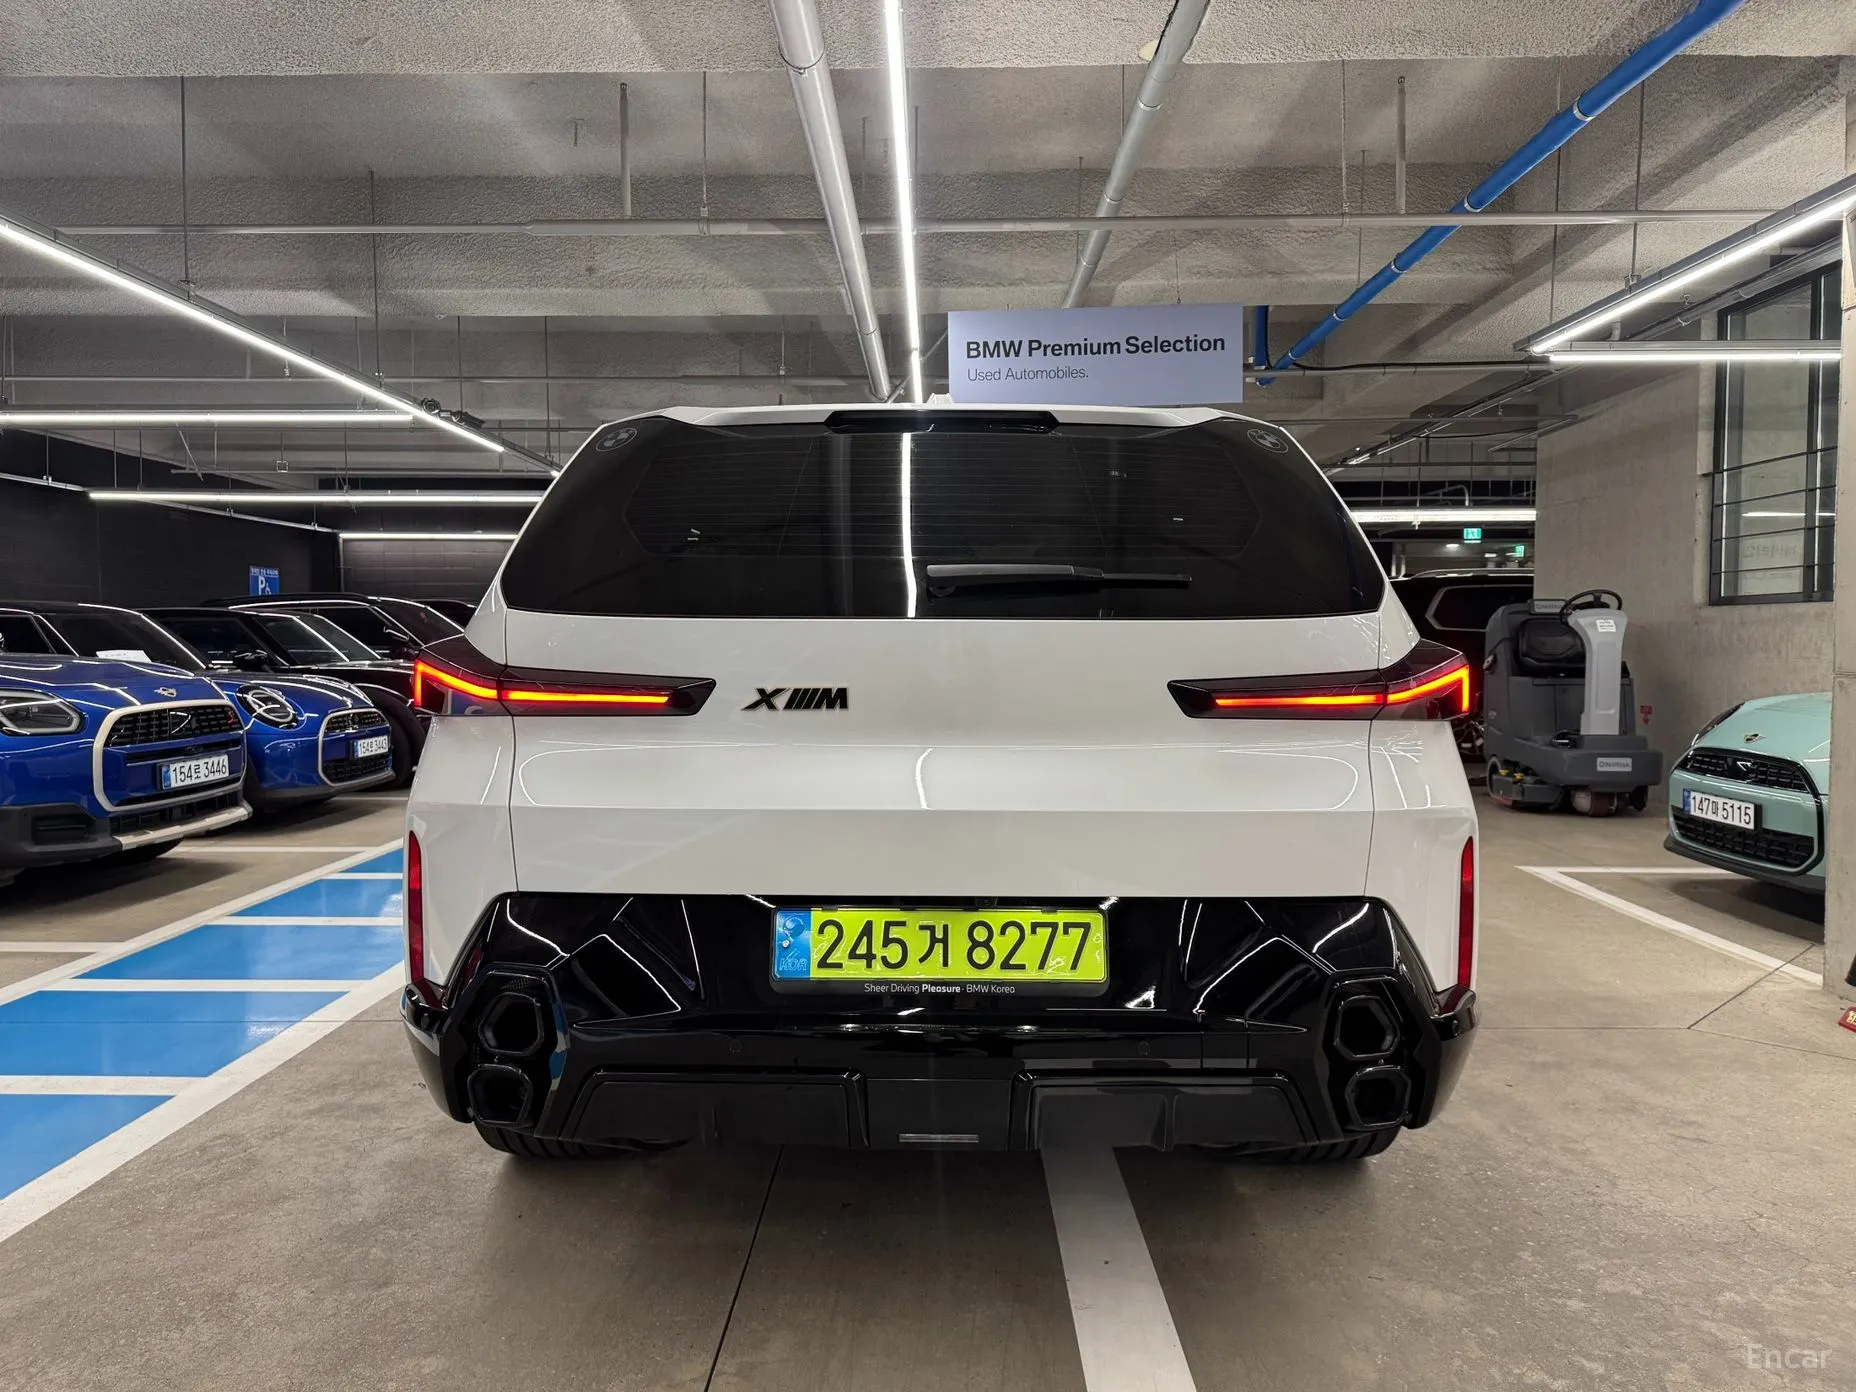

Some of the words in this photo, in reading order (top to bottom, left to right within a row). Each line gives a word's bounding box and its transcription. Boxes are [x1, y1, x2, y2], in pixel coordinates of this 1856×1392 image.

[966, 339, 1023, 359] BMW
[1028, 337, 1121, 357] Premium
[1125, 334, 1225, 354] Selection
[967, 367, 1001, 382] Used
[1005, 365, 1089, 381] Automobiles.
[172, 764, 202, 784] 154로
[203, 758, 228, 778] 3446
[1691, 795, 1719, 817] 147마
[1721, 801, 1752, 825] 5115
[816, 919, 950, 970] 245거
[966, 919, 1092, 971] 8277
[864, 983, 889, 993] Sheer
[891, 983, 920, 994] Driving
[966, 984, 989, 993] BMW
[991, 984, 1015, 993] Korea
